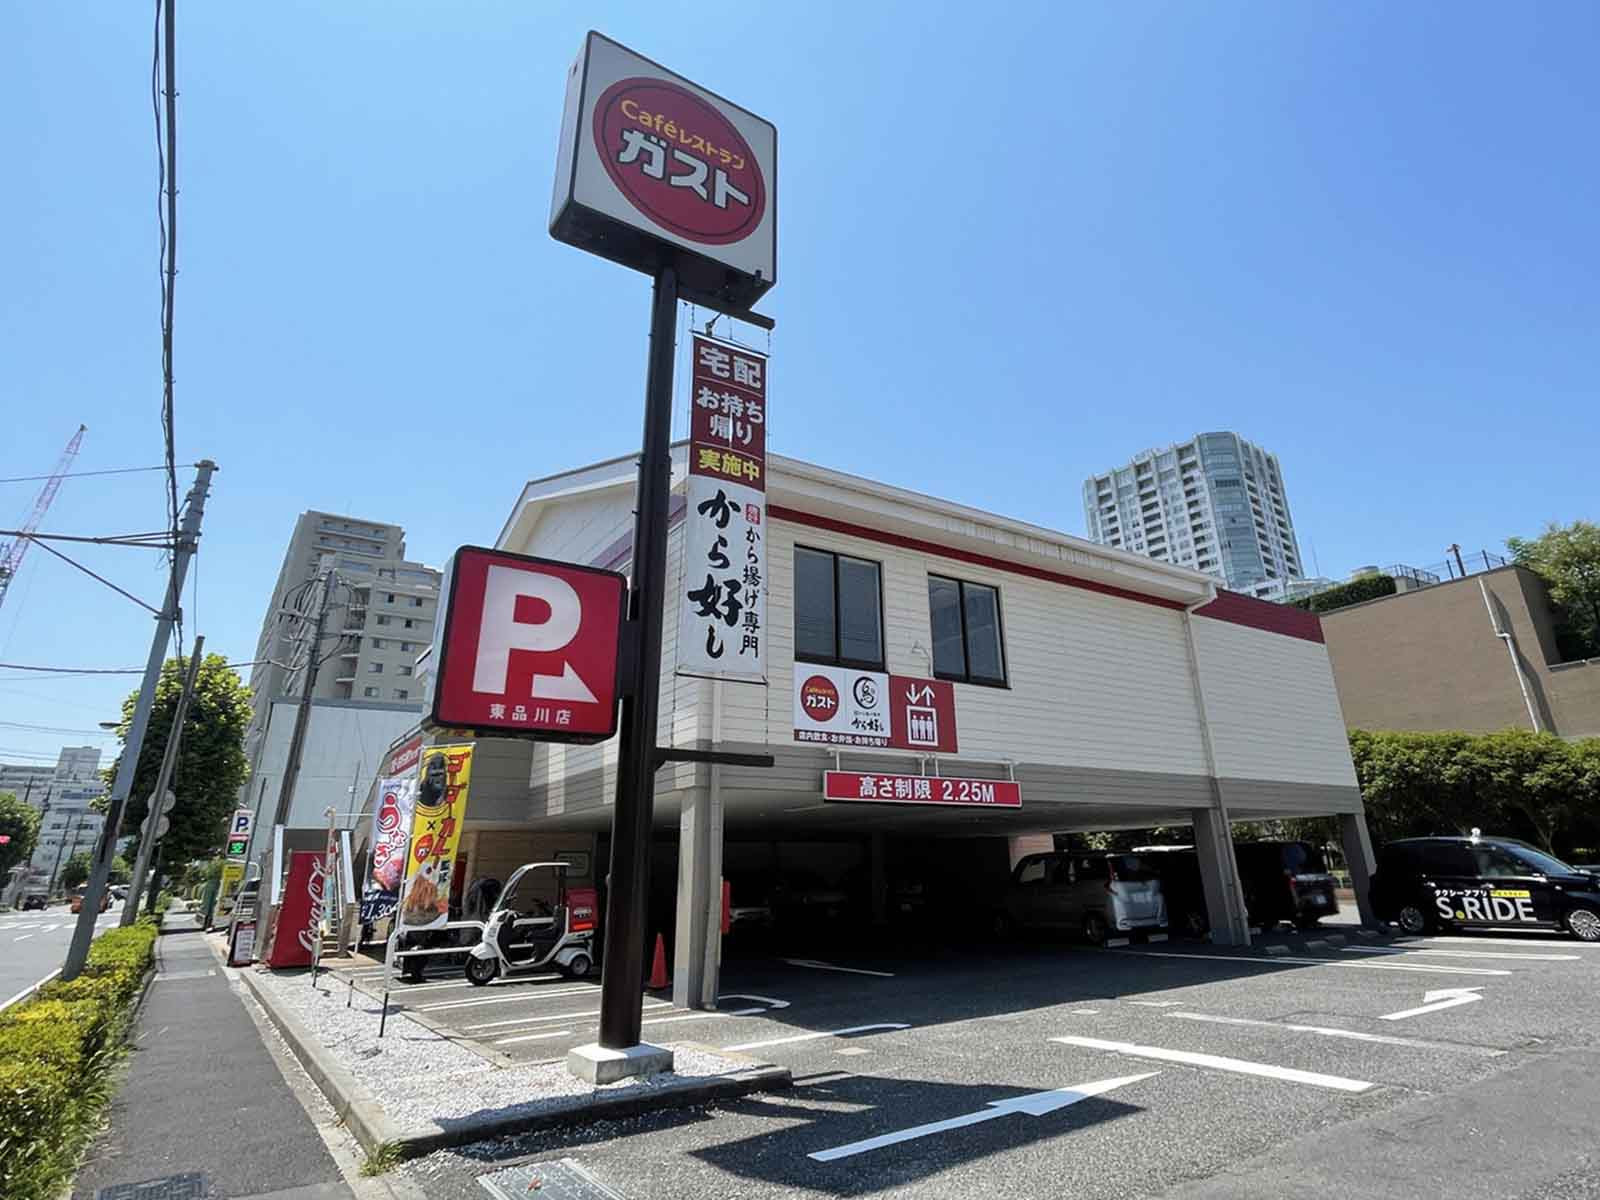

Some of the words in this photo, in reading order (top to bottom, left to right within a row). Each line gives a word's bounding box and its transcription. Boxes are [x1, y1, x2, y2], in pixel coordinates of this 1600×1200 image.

[618, 129, 750, 209] ガスト
[700, 346, 762, 389] 宅配
[696, 386, 763, 424] お持ち
[710, 414, 752, 445] 帰り
[699, 449, 760, 481] 実施中
[687, 489, 744, 659] から好し
[739, 526, 762, 659] から揚げ専門
[472, 564, 582, 695] P
[489, 703, 572, 725] 東品川店
[806, 694, 836, 709] ガスト
[859, 776, 932, 799] 高さ制限
[942, 781, 996, 803] 2.25M
[235, 816, 249, 833] P
[298, 855, 328, 952] Coca-Col
[1434, 889, 1488, 897] タクシーアプリ
[1436, 897, 1537, 921] S.RIDE
